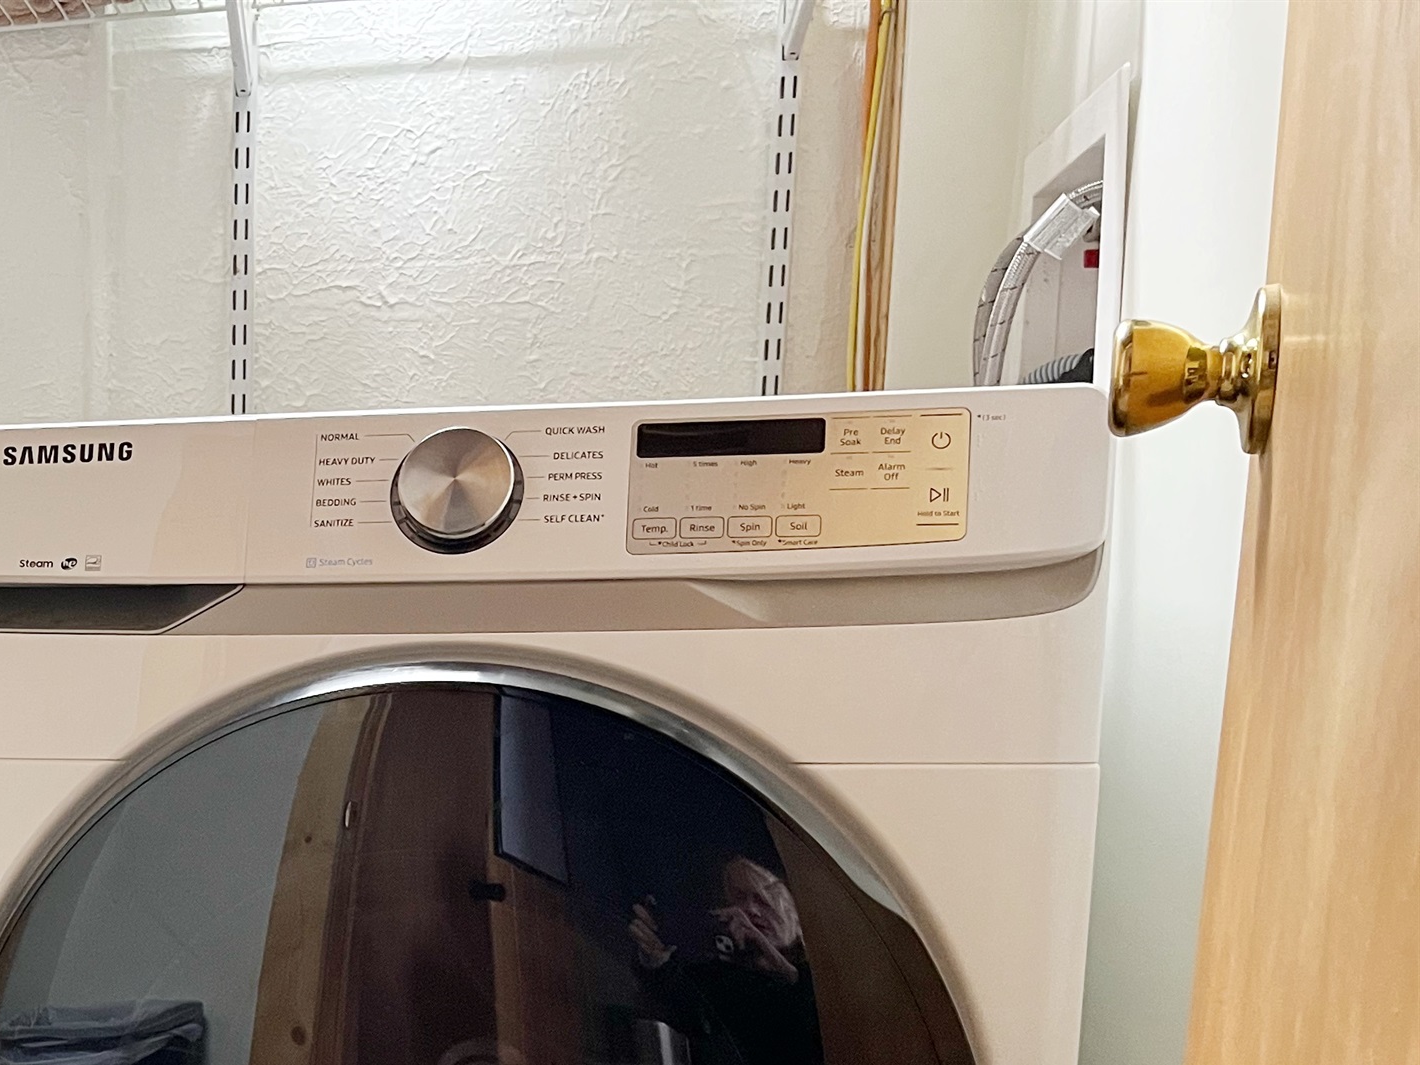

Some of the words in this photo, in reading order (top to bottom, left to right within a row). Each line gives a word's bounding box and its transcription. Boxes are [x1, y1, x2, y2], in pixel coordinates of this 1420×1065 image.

[545, 427, 575, 436] QUICK
[576, 426, 606, 434] WASH
[843, 428, 859, 437] Pre
[880, 427, 906, 437] Delay
[320, 433, 360, 441] NORMAL
[884, 437, 901, 445] End
[840, 438, 861, 446] Soak
[3, 441, 133, 466] SAMSUNG
[553, 451, 604, 460] DELICATES
[318, 458, 349, 466] HEAVY
[351, 457, 376, 465] DUTY
[878, 463, 906, 471] Alarm
[548, 472, 573, 481] PERM
[574, 472, 603, 480] PRESS
[835, 469, 864, 477] Steam
[884, 473, 899, 481] Off
[317, 478, 352, 486] WHITES
[543, 494, 571, 502] RINSE
[579, 493, 601, 501] SPIN
[315, 498, 357, 507] BEDDING
[751, 503, 766, 511] Spin
[544, 514, 566, 523] SELF
[314, 519, 354, 528] SANITIZE
[689, 524, 716, 532] Rinse
[739, 522, 761, 532] Spin
[790, 521, 808, 530] Soil
[641, 524, 669, 534] Temp.
[19, 560, 54, 568] Steam
[347, 558, 373, 567] Cycles
